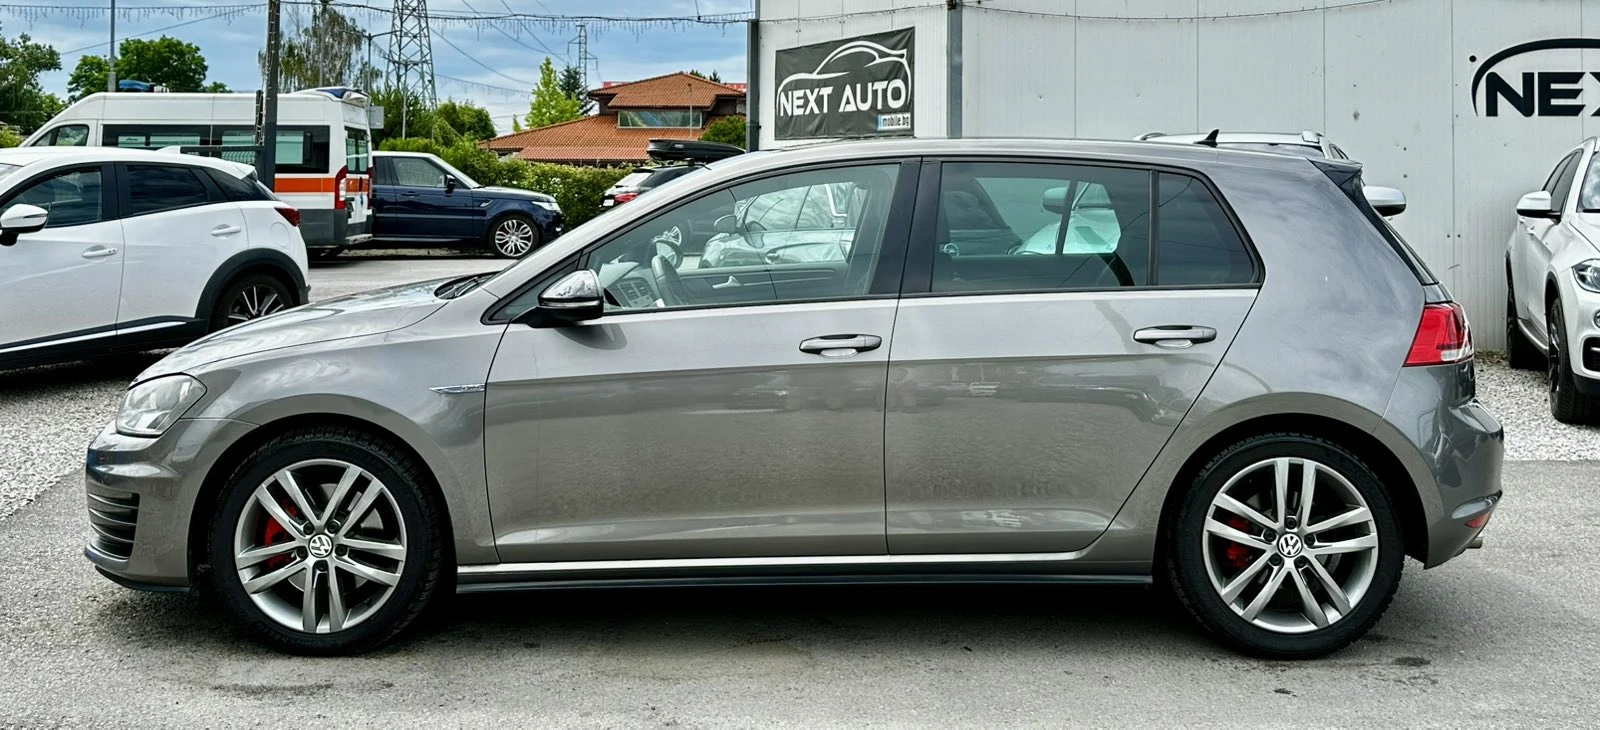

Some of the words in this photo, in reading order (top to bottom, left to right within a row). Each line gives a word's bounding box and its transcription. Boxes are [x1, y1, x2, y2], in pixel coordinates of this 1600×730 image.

[779, 86, 834, 117] NEXT
[838, 78, 906, 113] AUTO
[1485, 71, 1600, 117] NE
[882, 115, 910, 127] mobile.bg
